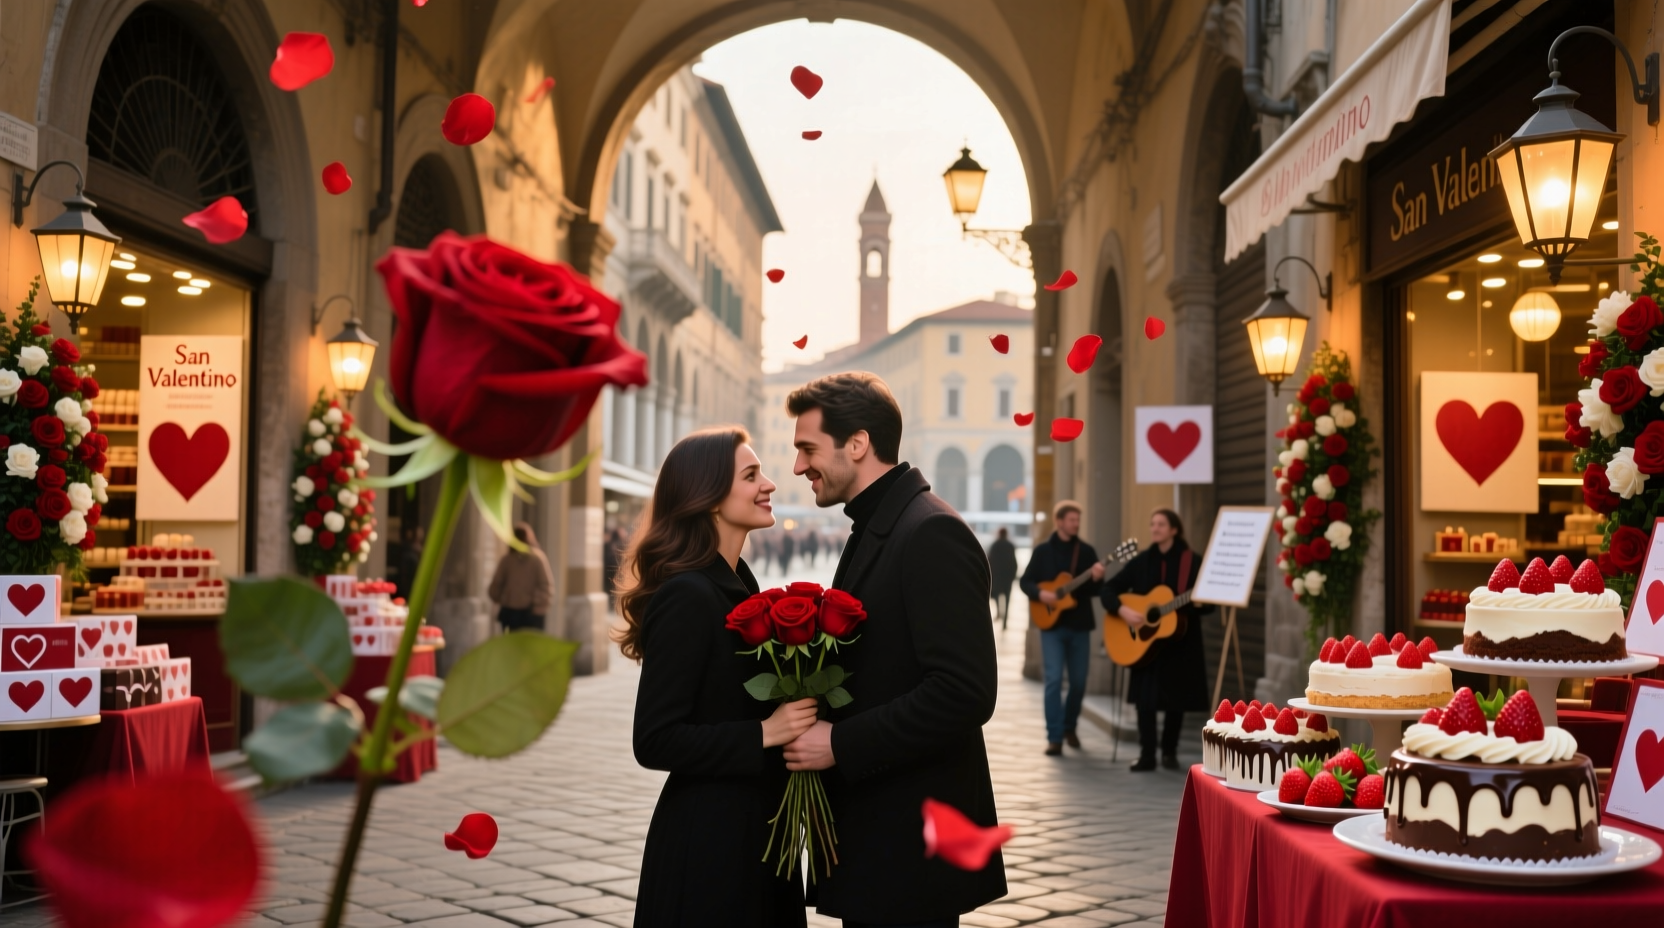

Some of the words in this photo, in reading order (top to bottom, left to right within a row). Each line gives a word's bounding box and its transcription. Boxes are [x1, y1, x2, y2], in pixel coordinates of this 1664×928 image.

[1390, 181, 1427, 241] San
[1431, 133, 1503, 216] Valen
[174, 343, 210, 365] San
[147, 367, 237, 388] Valentino
